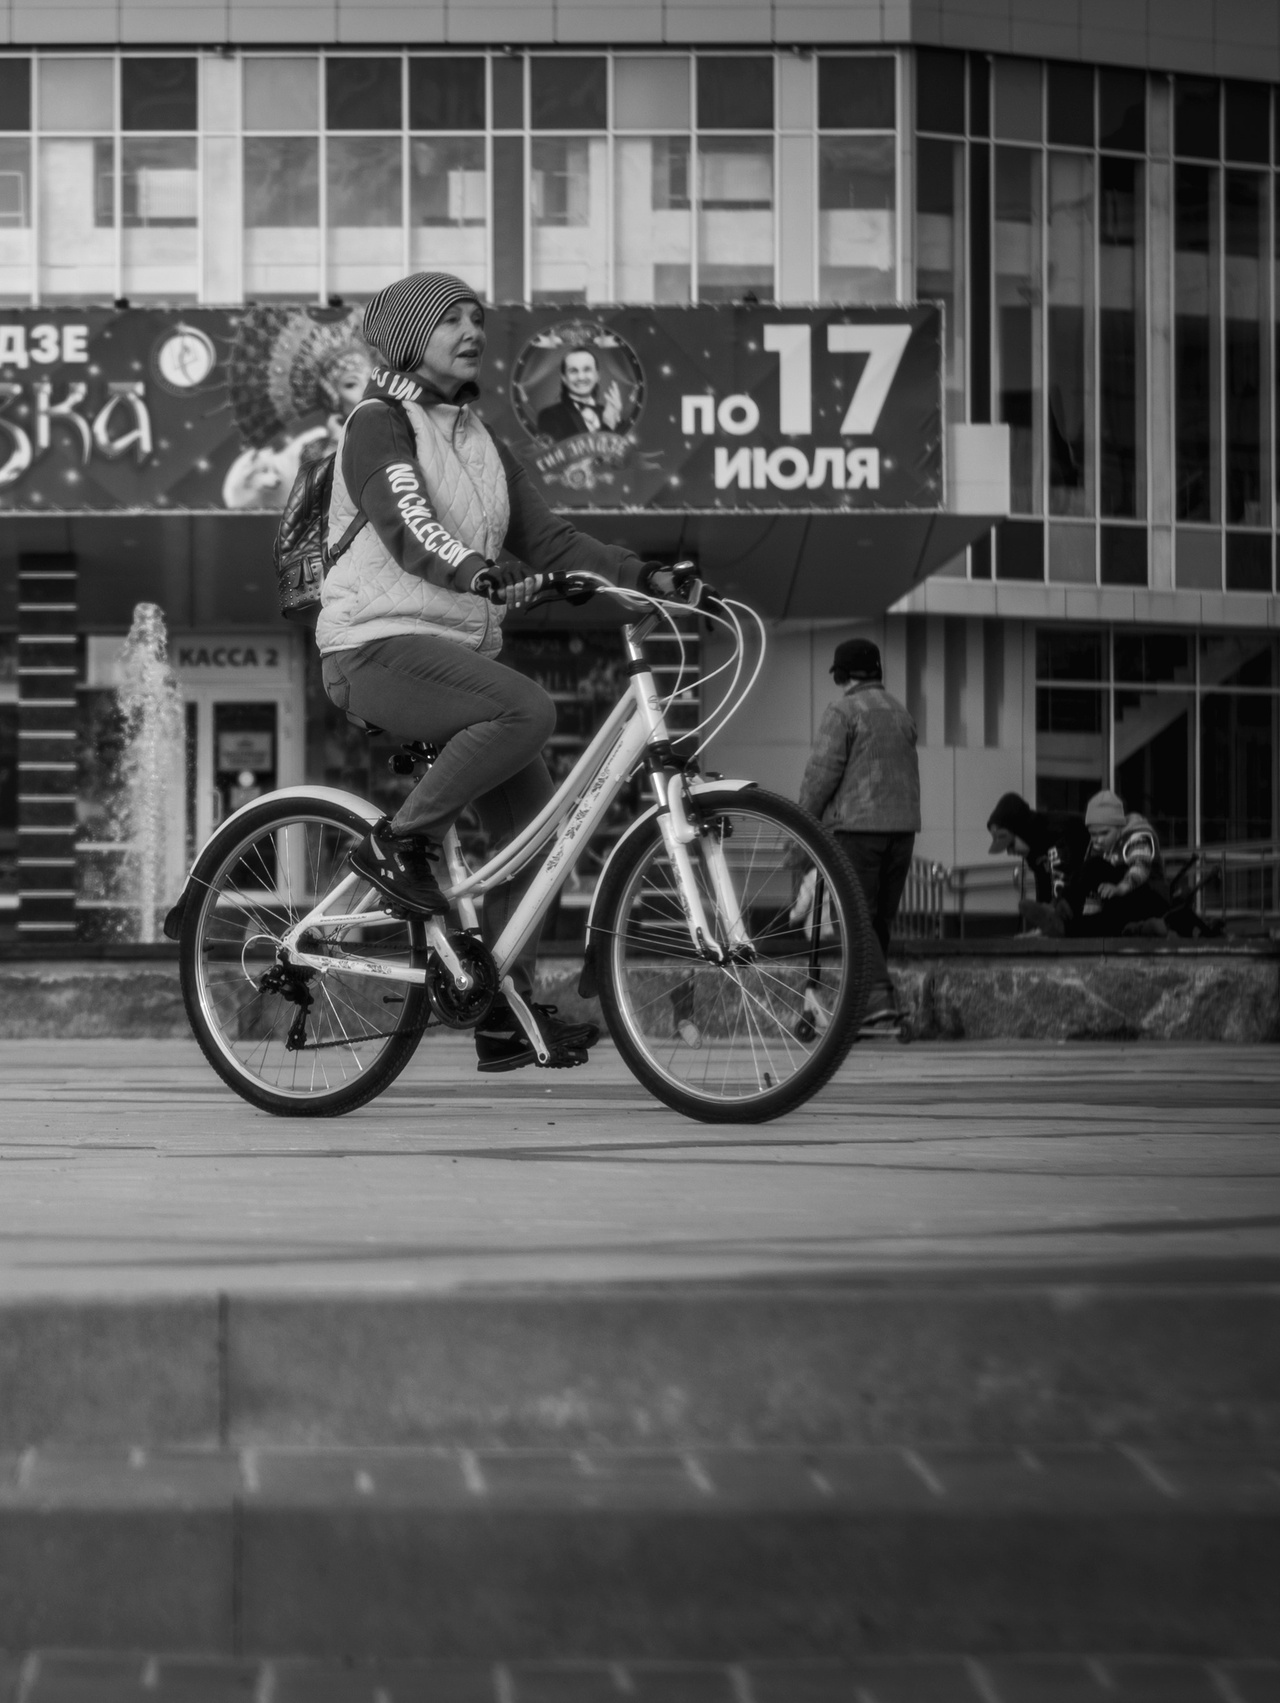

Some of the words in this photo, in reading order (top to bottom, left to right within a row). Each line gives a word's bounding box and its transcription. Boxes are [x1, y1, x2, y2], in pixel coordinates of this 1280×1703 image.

[763, 324, 912, 436] 17
[385, 463, 420, 494] NO
[178, 649, 259, 667] КАССА
[264, 649, 278, 667] 2
